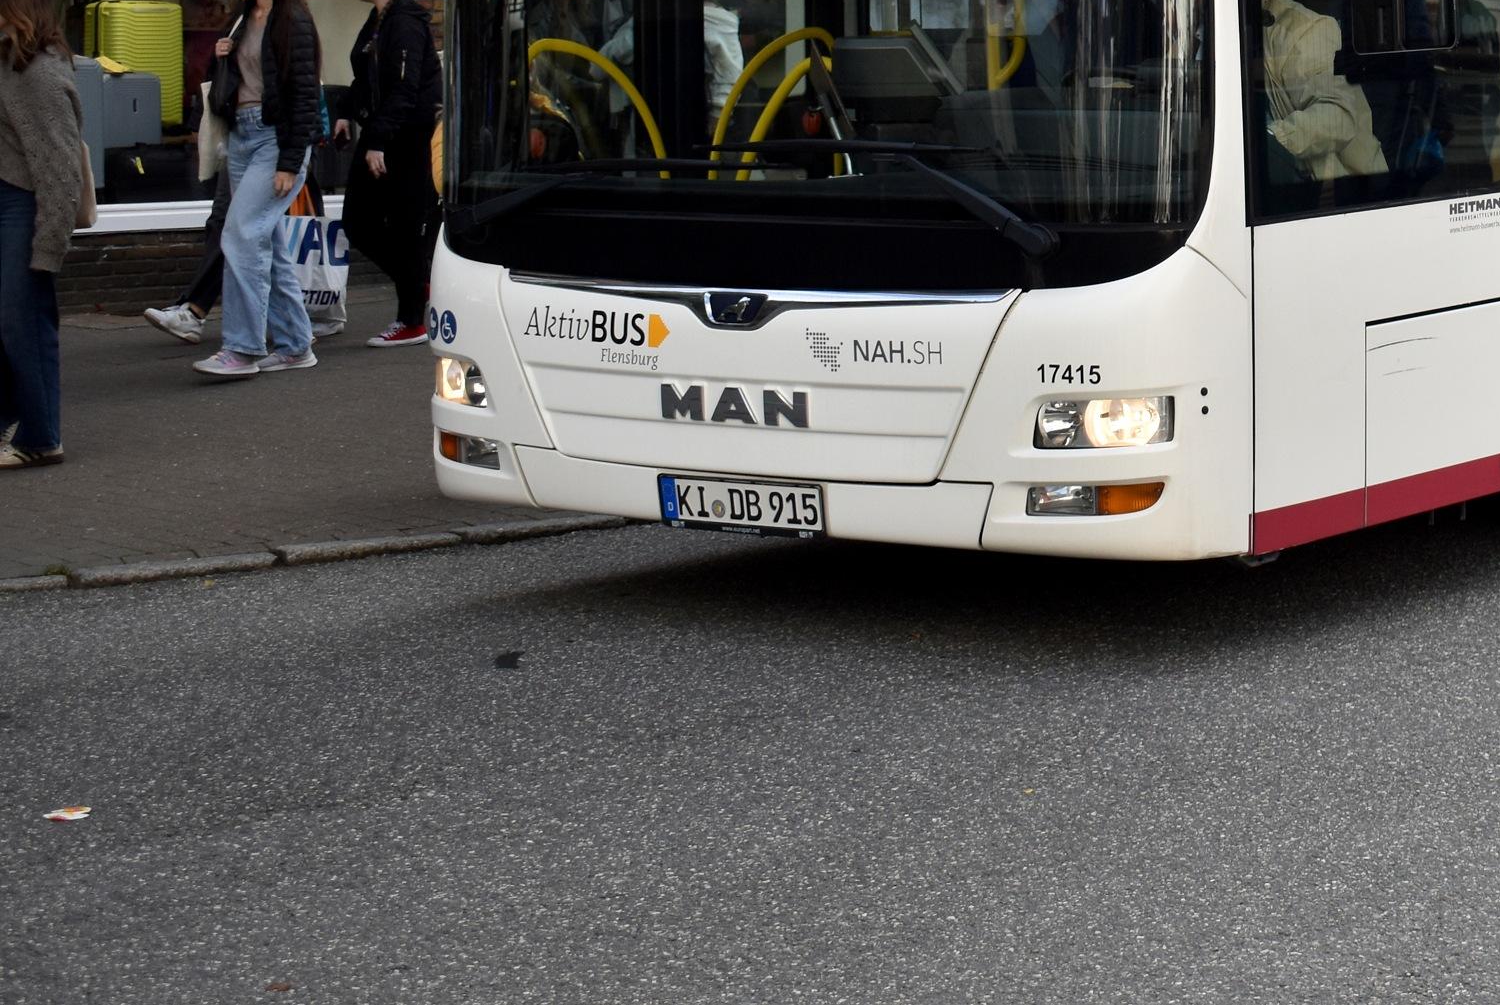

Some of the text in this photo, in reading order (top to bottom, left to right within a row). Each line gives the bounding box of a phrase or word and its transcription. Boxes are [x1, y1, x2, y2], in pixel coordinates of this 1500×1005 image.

[524, 305, 646, 347] AktivBUS
[600, 348, 659, 370] Flensburg
[853, 337, 944, 366] NAH.SH
[1036, 362, 1102, 385] 17415
[660, 383, 809, 428] MAN
[676, 484, 710, 517] KI
[727, 488, 763, 522] DB
[769, 491, 819, 525] 915
